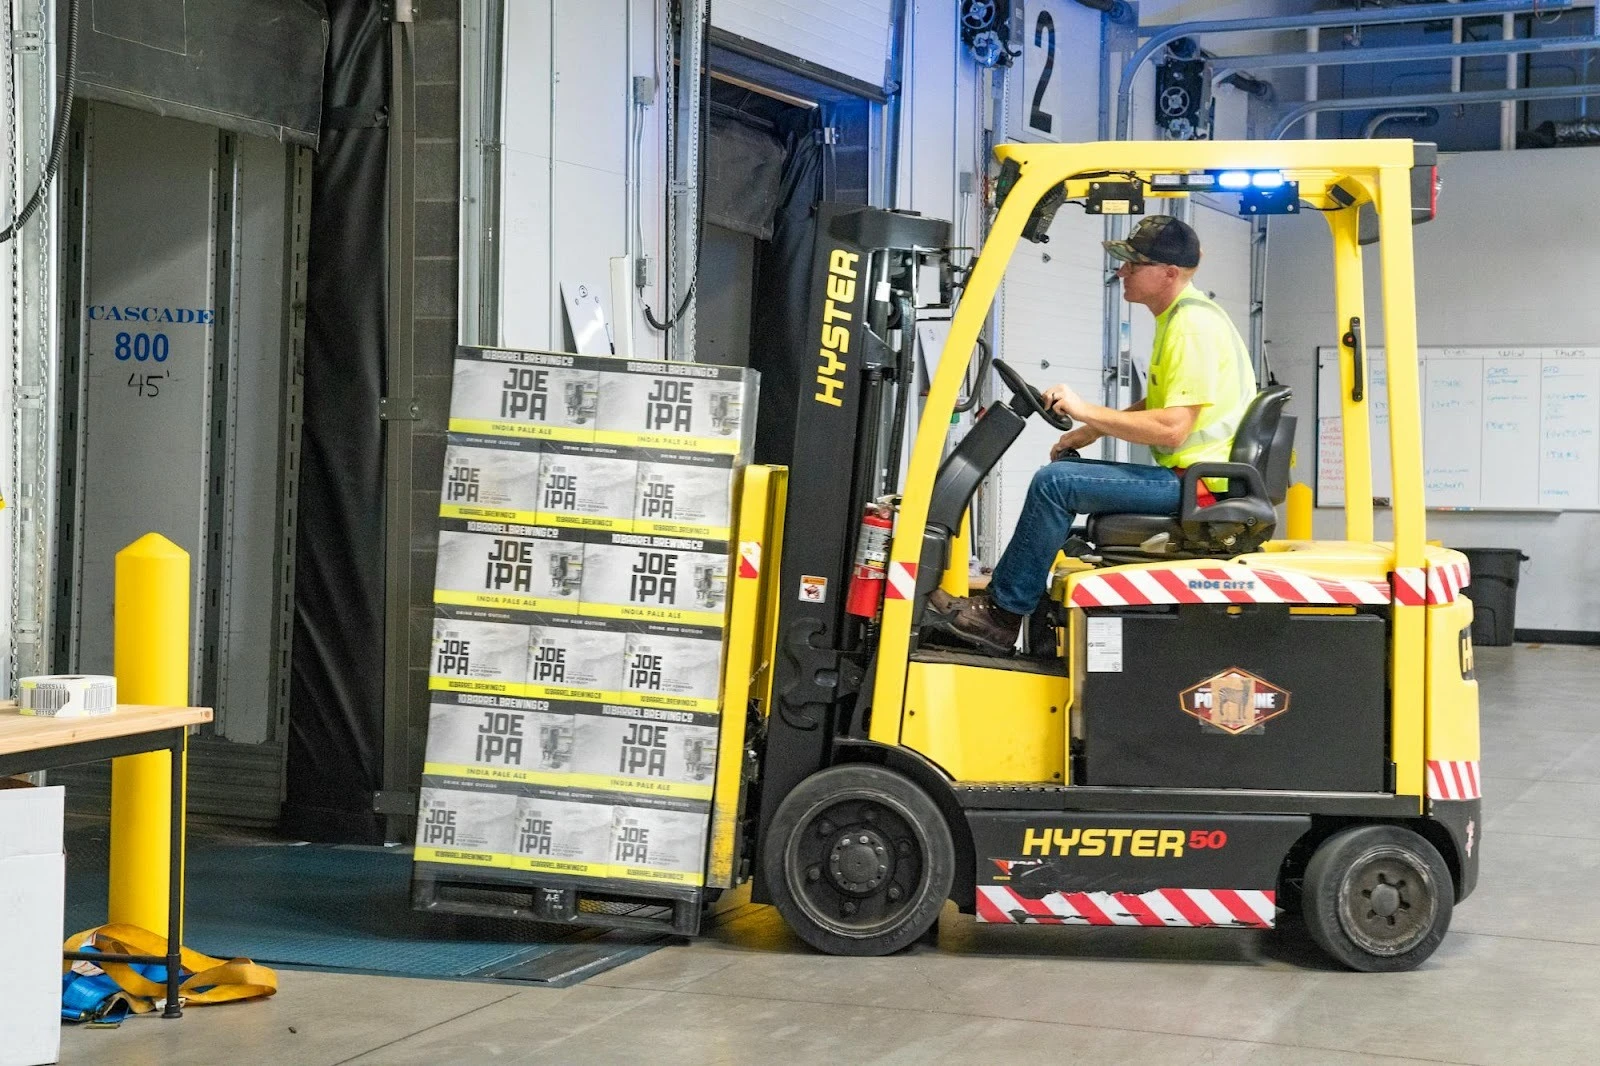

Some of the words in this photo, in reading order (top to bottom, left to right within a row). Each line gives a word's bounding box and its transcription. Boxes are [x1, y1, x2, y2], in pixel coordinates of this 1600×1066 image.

[1029, 11, 1057, 134] 2
[88, 305, 214, 324] CASCADE
[815, 249, 859, 407] HYSTER
[115, 332, 169, 362] 800
[504, 368, 549, 392] JOE
[649, 380, 694, 404] JOE
[500, 391, 547, 421] IPA
[646, 402, 692, 432] IPA
[449, 466, 480, 483] JOE
[546, 474, 577, 491] JOE
[447, 482, 480, 502] IPA
[544, 490, 576, 510] IPA
[643, 482, 675, 499] JOE
[642, 498, 673, 519] IPA
[488, 539, 534, 564] JOE
[632, 552, 678, 576] JOE
[485, 562, 532, 592] IPA
[630, 574, 676, 604] IPA
[476, 595, 500, 603] INDIA
[502, 597, 522, 605] PALE
[523, 599, 537, 607] ALE
[621, 608, 645, 616] INDIA
[647, 610, 666, 618] PALE
[439, 639, 470, 656] JOE
[535, 646, 566, 663] JOE
[437, 655, 469, 676] IPA
[533, 662, 565, 683] IPA
[631, 654, 662, 670] JOE
[629, 669, 661, 690] IPA
[478, 712, 524, 736] JOE
[623, 723, 668, 748] JOE
[476, 735, 522, 765] IPA
[619, 746, 666, 777] IPA
[425, 809, 457, 826] JOE
[521, 818, 553, 835] JOE
[423, 824, 456, 845] IPA
[519, 834, 552, 855] IPA
[618, 827, 649, 844] JOE
[1022, 828, 1186, 857] HYSTER
[1188, 830, 1227, 849] 50
[616, 842, 648, 864] IPA
